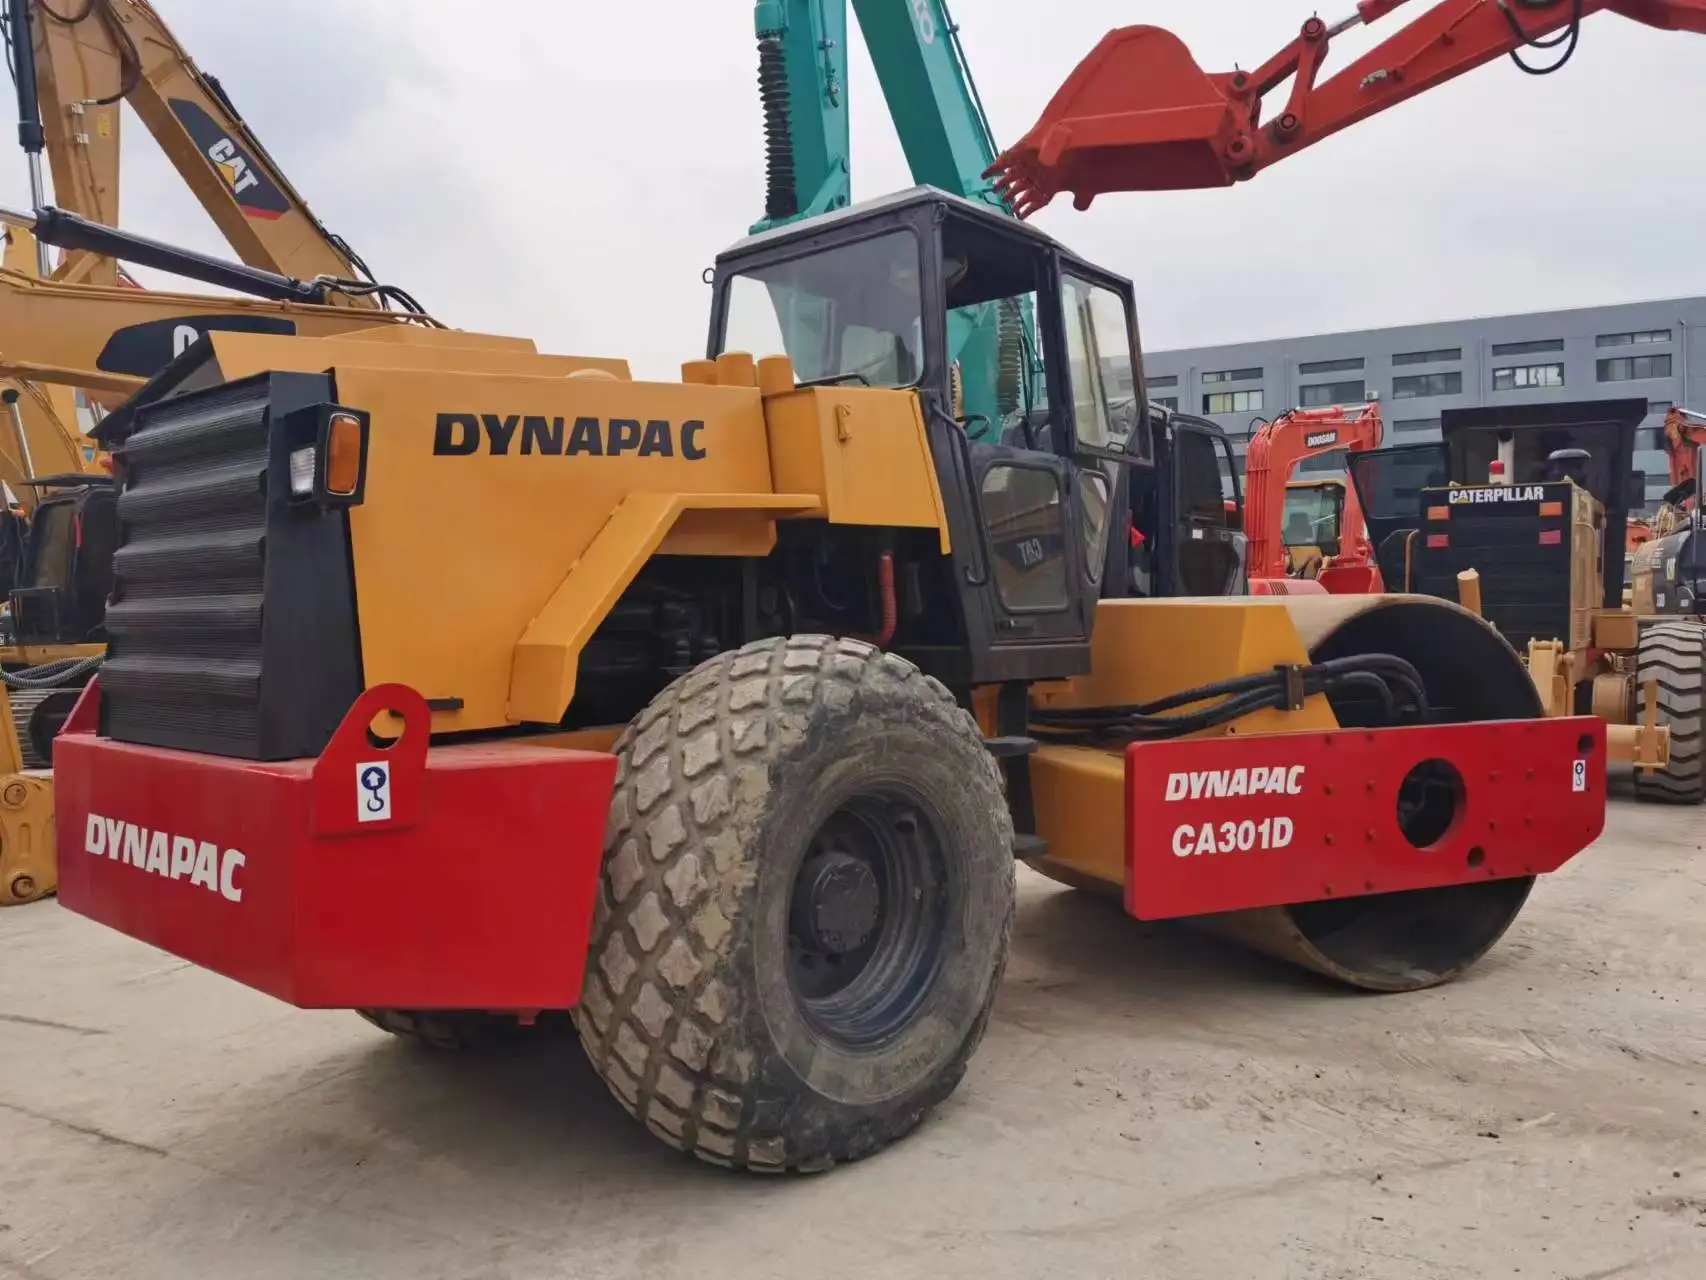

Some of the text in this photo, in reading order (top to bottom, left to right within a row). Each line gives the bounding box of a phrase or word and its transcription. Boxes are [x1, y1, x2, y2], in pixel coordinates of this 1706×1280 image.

[208, 138, 259, 194] CAT
[432, 412, 707, 461] DYNAPAC
[1449, 486, 1544, 504] CATERPILLAR
[1165, 765, 1306, 802] DYNAPAC
[85, 813, 246, 903] DYNAPAC
[1172, 816, 1294, 857] CA301D
